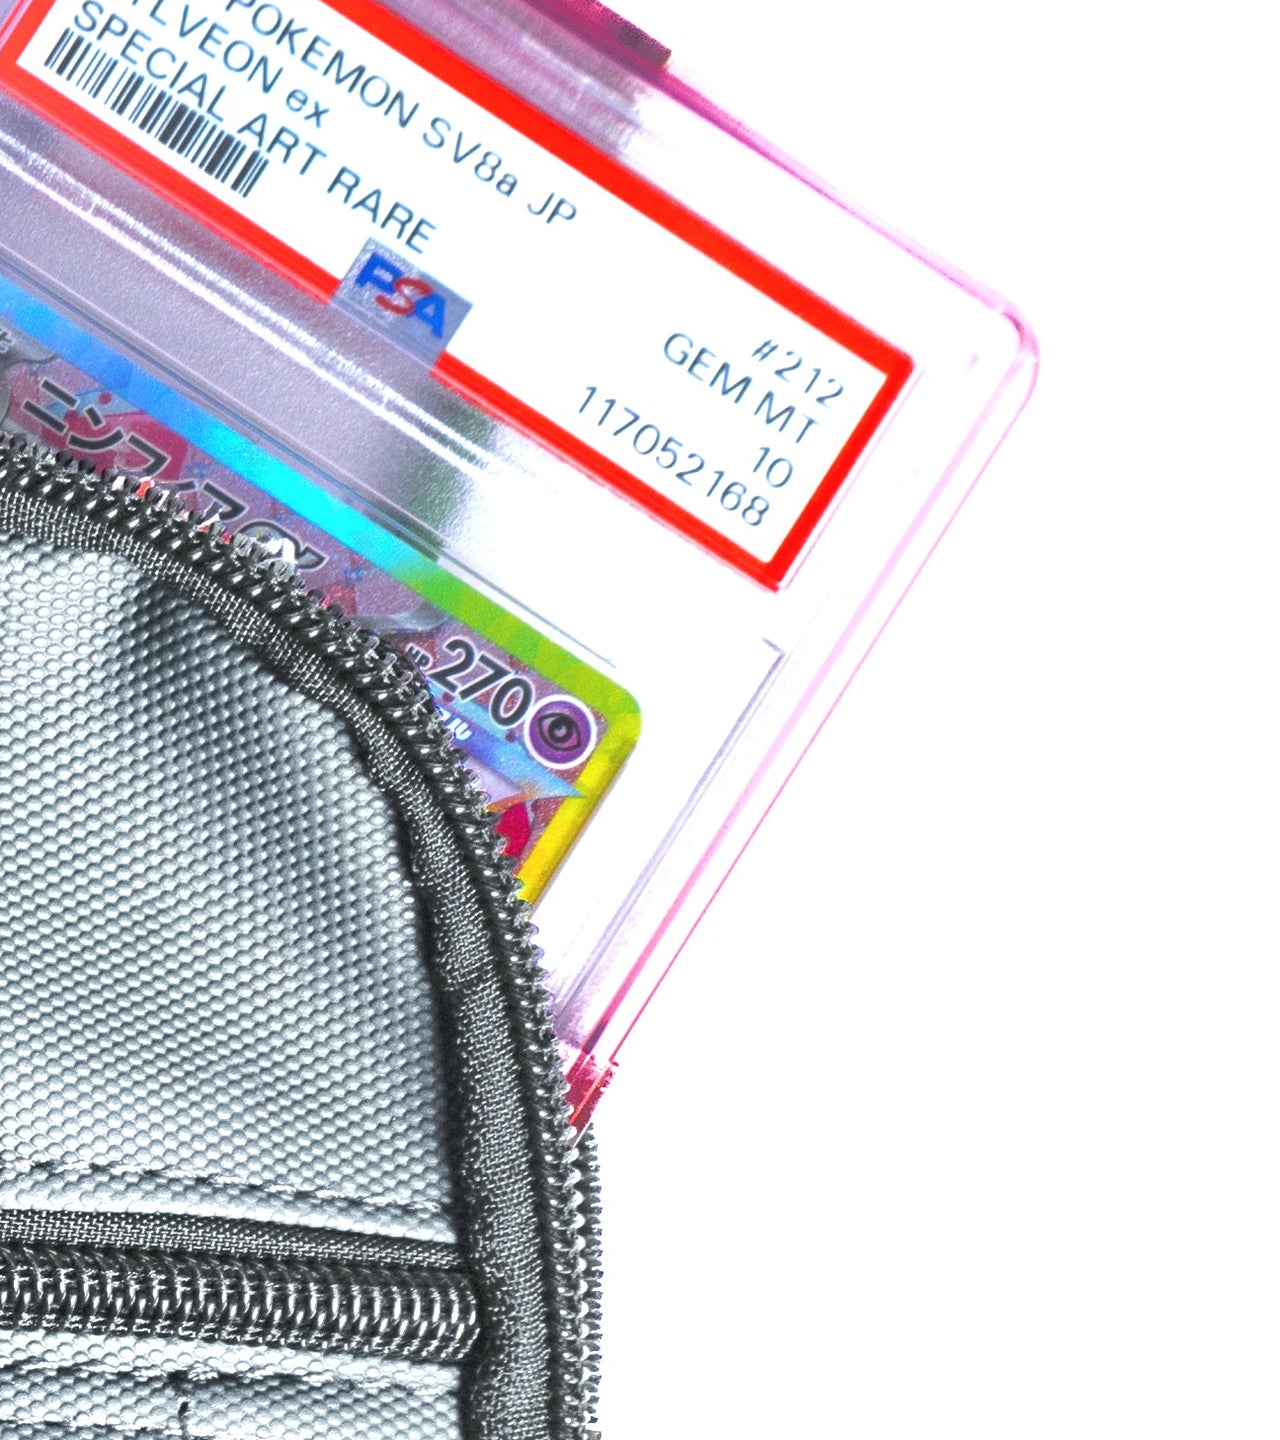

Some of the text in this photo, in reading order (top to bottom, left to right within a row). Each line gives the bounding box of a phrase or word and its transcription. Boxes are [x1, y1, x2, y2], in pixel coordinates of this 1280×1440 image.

[73, 0, 438, 255] SPECIAL ART RARE
[285, 88, 331, 129] ex
[422, 116, 519, 198] SV8a
[526, 191, 578, 226] JP
[354, 250, 449, 341] PSA
[663, 332, 820, 444] GEM MT
[750, 339, 844, 409] #212
[578, 385, 770, 527] 117052168
[752, 446, 794, 488] 10
[425, 635, 535, 728] 270
